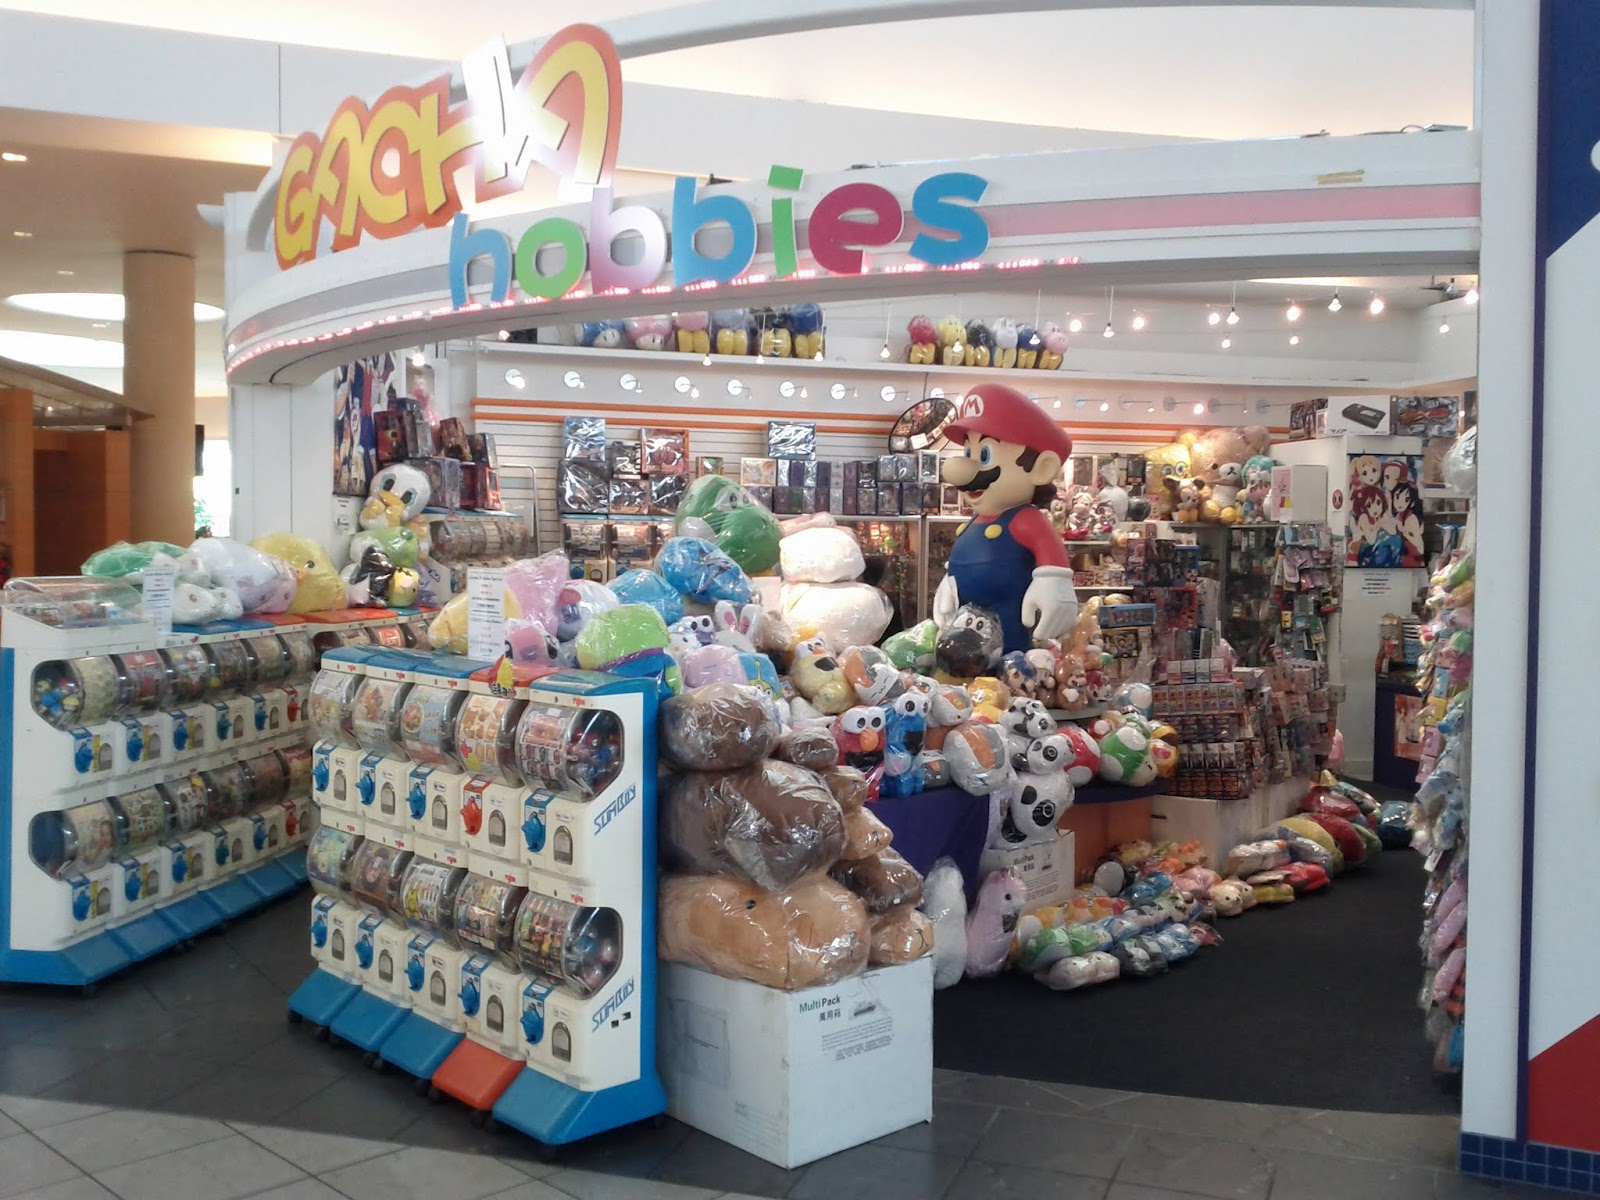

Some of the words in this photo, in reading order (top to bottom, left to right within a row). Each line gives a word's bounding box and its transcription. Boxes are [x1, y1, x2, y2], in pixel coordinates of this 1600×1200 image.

[276, 24, 621, 270] GACHA
[449, 165, 990, 310] hobbies
[965, 396, 981, 416] M
